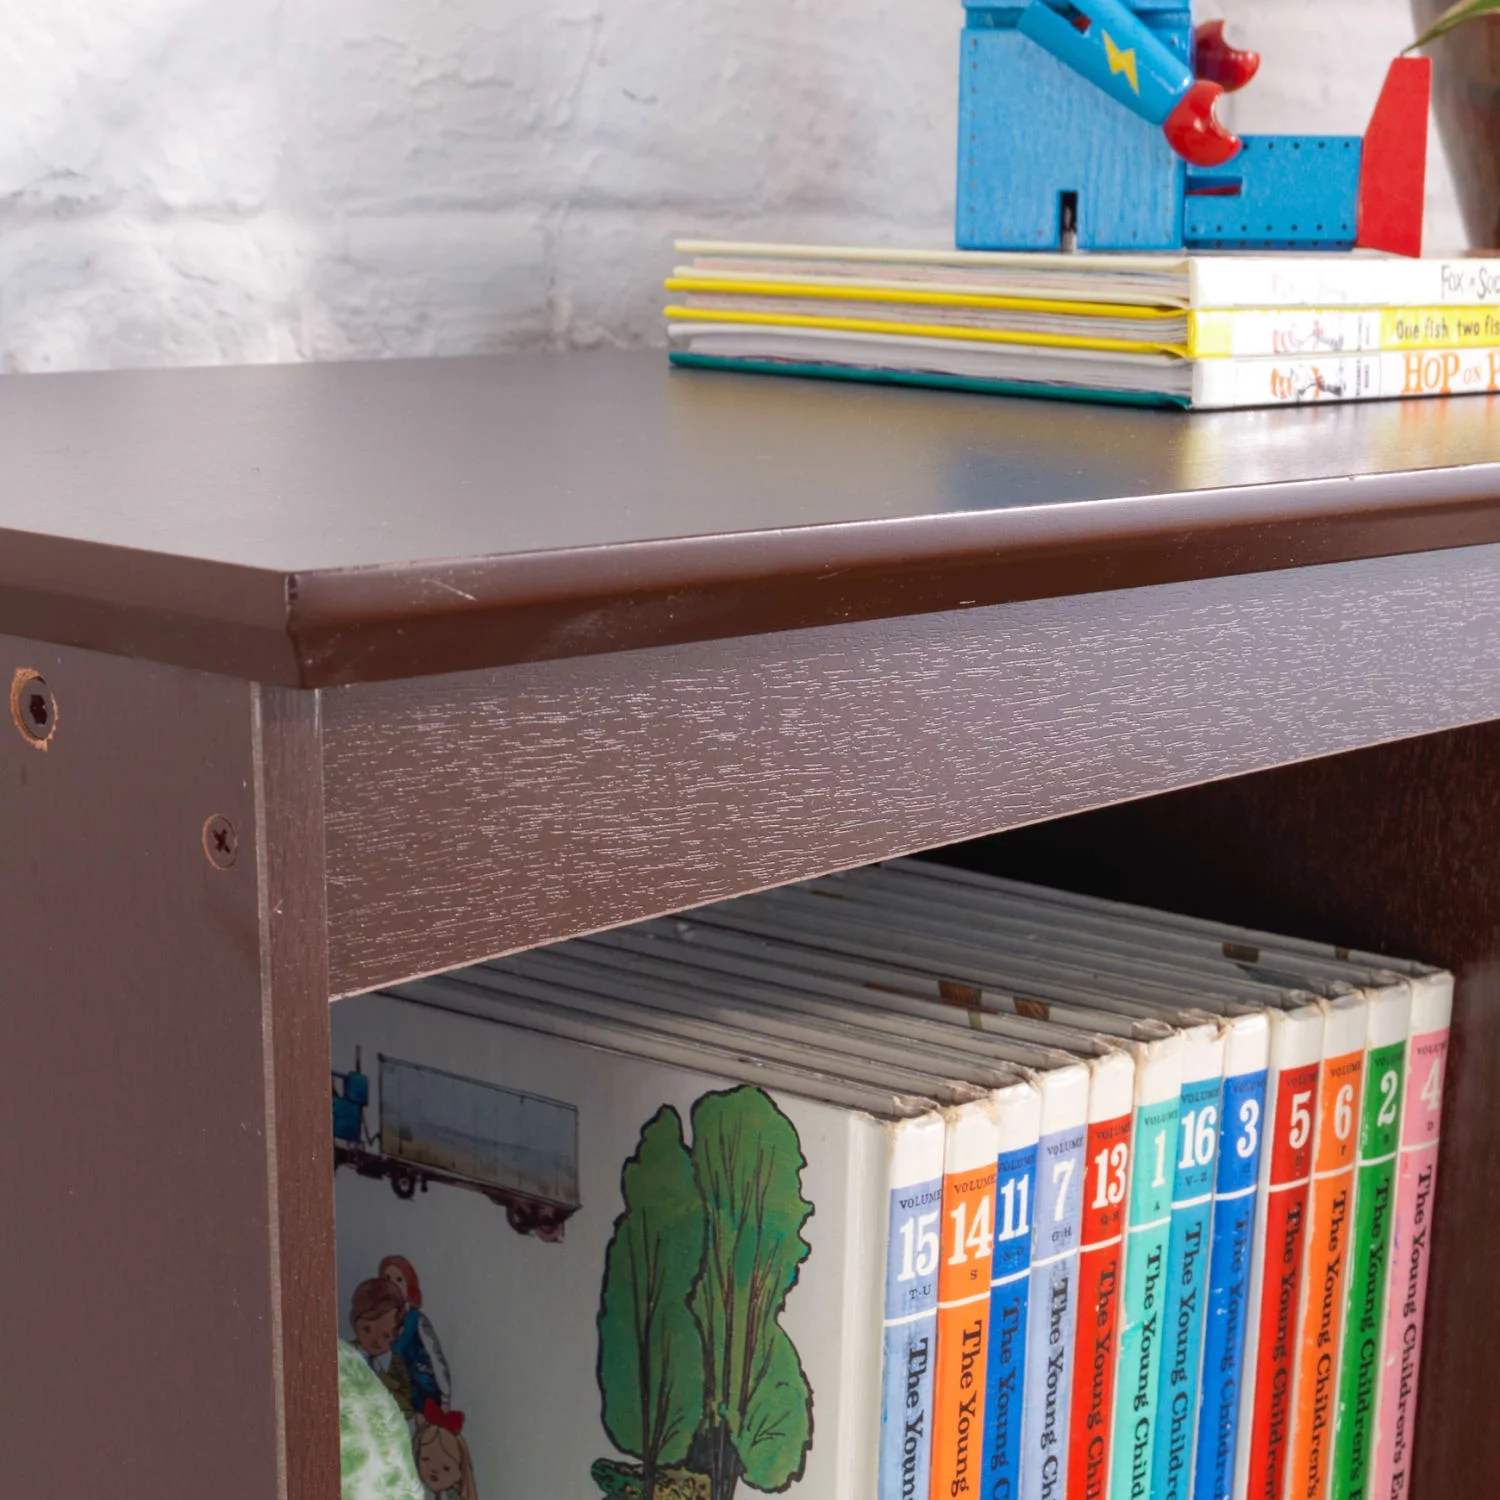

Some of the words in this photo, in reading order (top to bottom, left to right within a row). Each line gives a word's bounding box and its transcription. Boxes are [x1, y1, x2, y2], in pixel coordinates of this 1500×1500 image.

[1441, 263, 1465, 300] Fox
[1396, 319, 1420, 340] One
[1425, 316, 1448, 339] fish
[1457, 318, 1480, 337] two
[1334, 1083, 1354, 1141] 6
[1377, 1070, 1398, 1127] 2
[1420, 1058, 1441, 1111] 4
[1047, 1136, 1084, 1156] VOLUME
[1178, 1105, 1217, 1170] 16
[1236, 1099, 1260, 1159] 3
[1289, 1090, 1312, 1150] 5
[954, 1174, 996, 1194] VOLUME
[1052, 1157, 1075, 1223] 7
[1091, 1142, 1128, 1210] 13
[1152, 1129, 1166, 1188] 1
[999, 1173, 1029, 1242] 11
[1329, 1189, 1347, 1251] The
[1371, 1177, 1390, 1239] The
[1414, 1163, 1433, 1225] The
[897, 1210, 939, 1282] 15
[948, 1195, 994, 1266] 14
[1181, 1221, 1202, 1286] The
[1230, 1211, 1249, 1275] The
[1283, 1202, 1302, 1264] The
[969, 1268, 978, 1281] S
[1096, 1260, 1116, 1327] The
[1143, 1244, 1162, 1310] The
[1318, 1252, 1341, 1349] Young
[1360, 1240, 1385, 1333] Young
[1403, 1226, 1426, 1319] Young
[1000, 1296, 1020, 1366] The
[1049, 1277, 1069, 1345] The
[1171, 1287, 1196, 1387] Young
[1220, 1278, 1243, 1373] Young
[1273, 1266, 1297, 1362] Young
[906, 1336, 929, 1408] The
[960, 1320, 983, 1390] The
[1086, 1328, 1111, 1430] Young
[1133, 1311, 1158, 1412] Young
[991, 1367, 1016, 1471] Young
[1041, 1346, 1065, 1449] Young
[1308, 1353, 1331, 1499] Children's
[1393, 1323, 1417, 1464] Children's
[951, 1390, 978, 1497] Young
